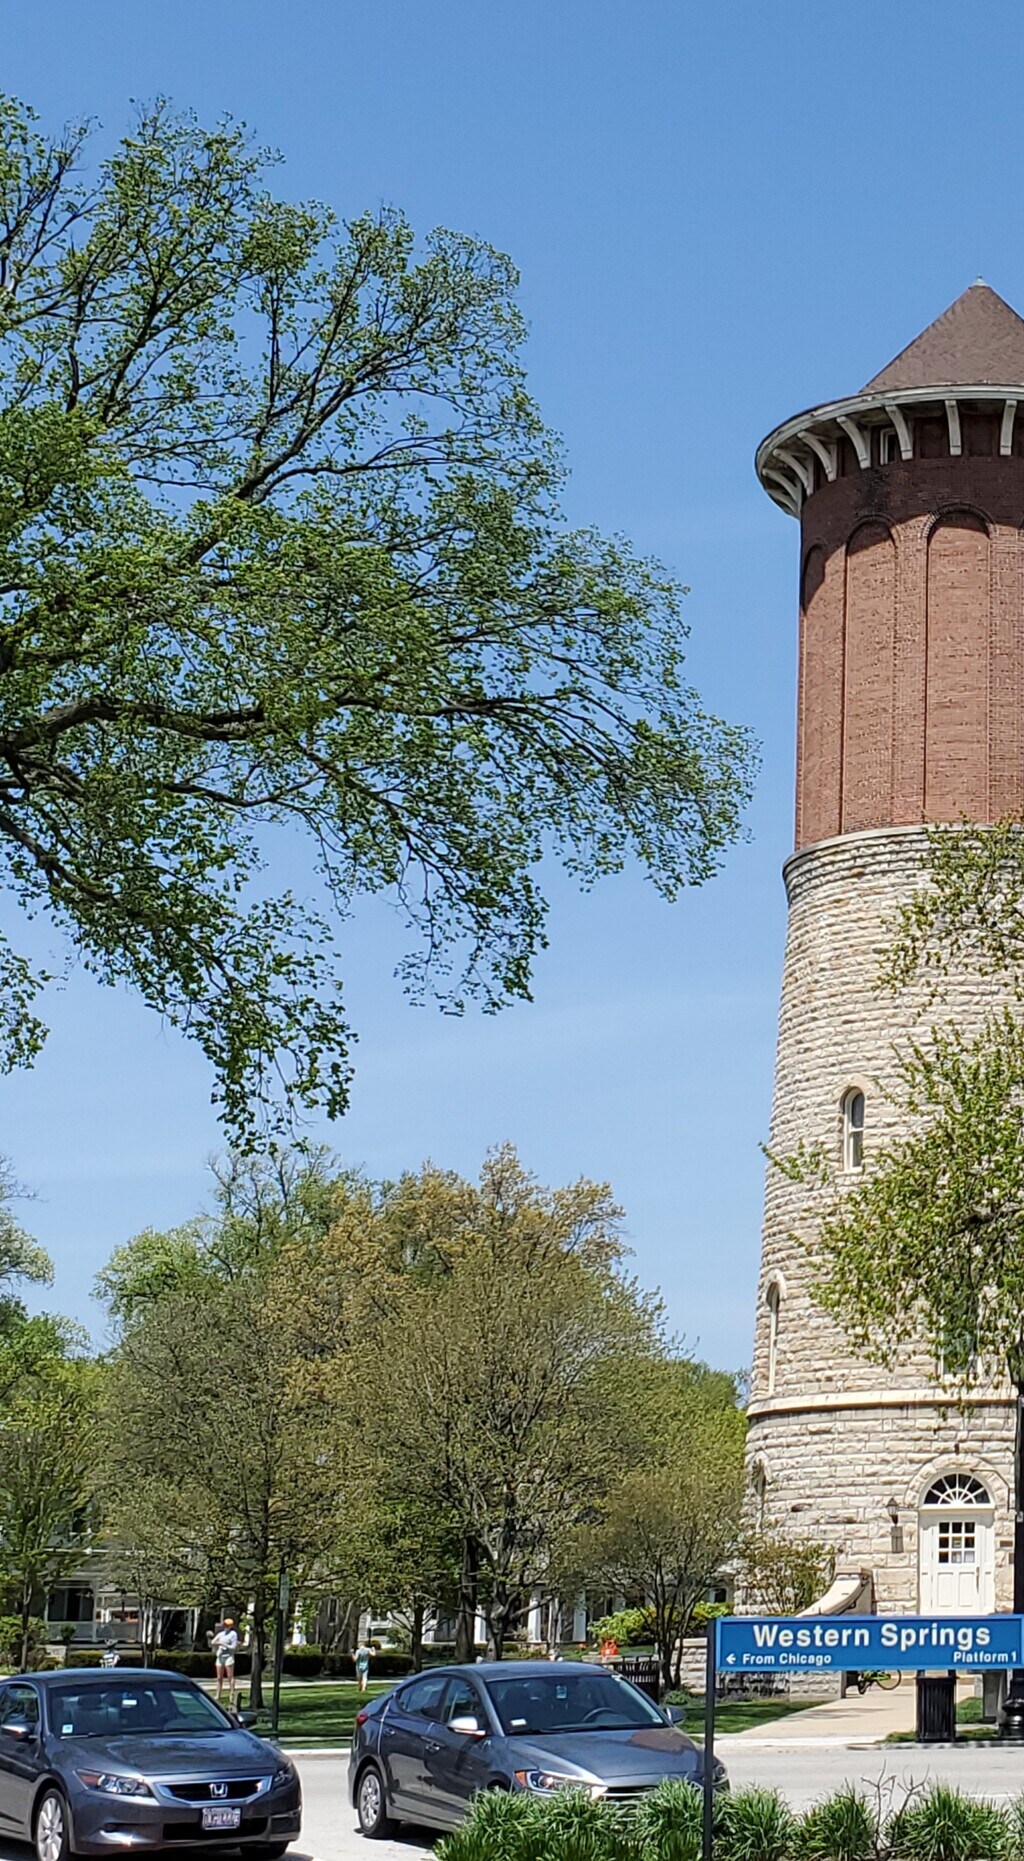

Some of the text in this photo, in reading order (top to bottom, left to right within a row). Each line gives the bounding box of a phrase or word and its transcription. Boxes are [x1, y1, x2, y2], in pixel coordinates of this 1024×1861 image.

[753, 1622, 991, 1652] Western Springs
[742, 1652, 832, 1666] From Chicago
[953, 1651, 1017, 1663] Platform 1
